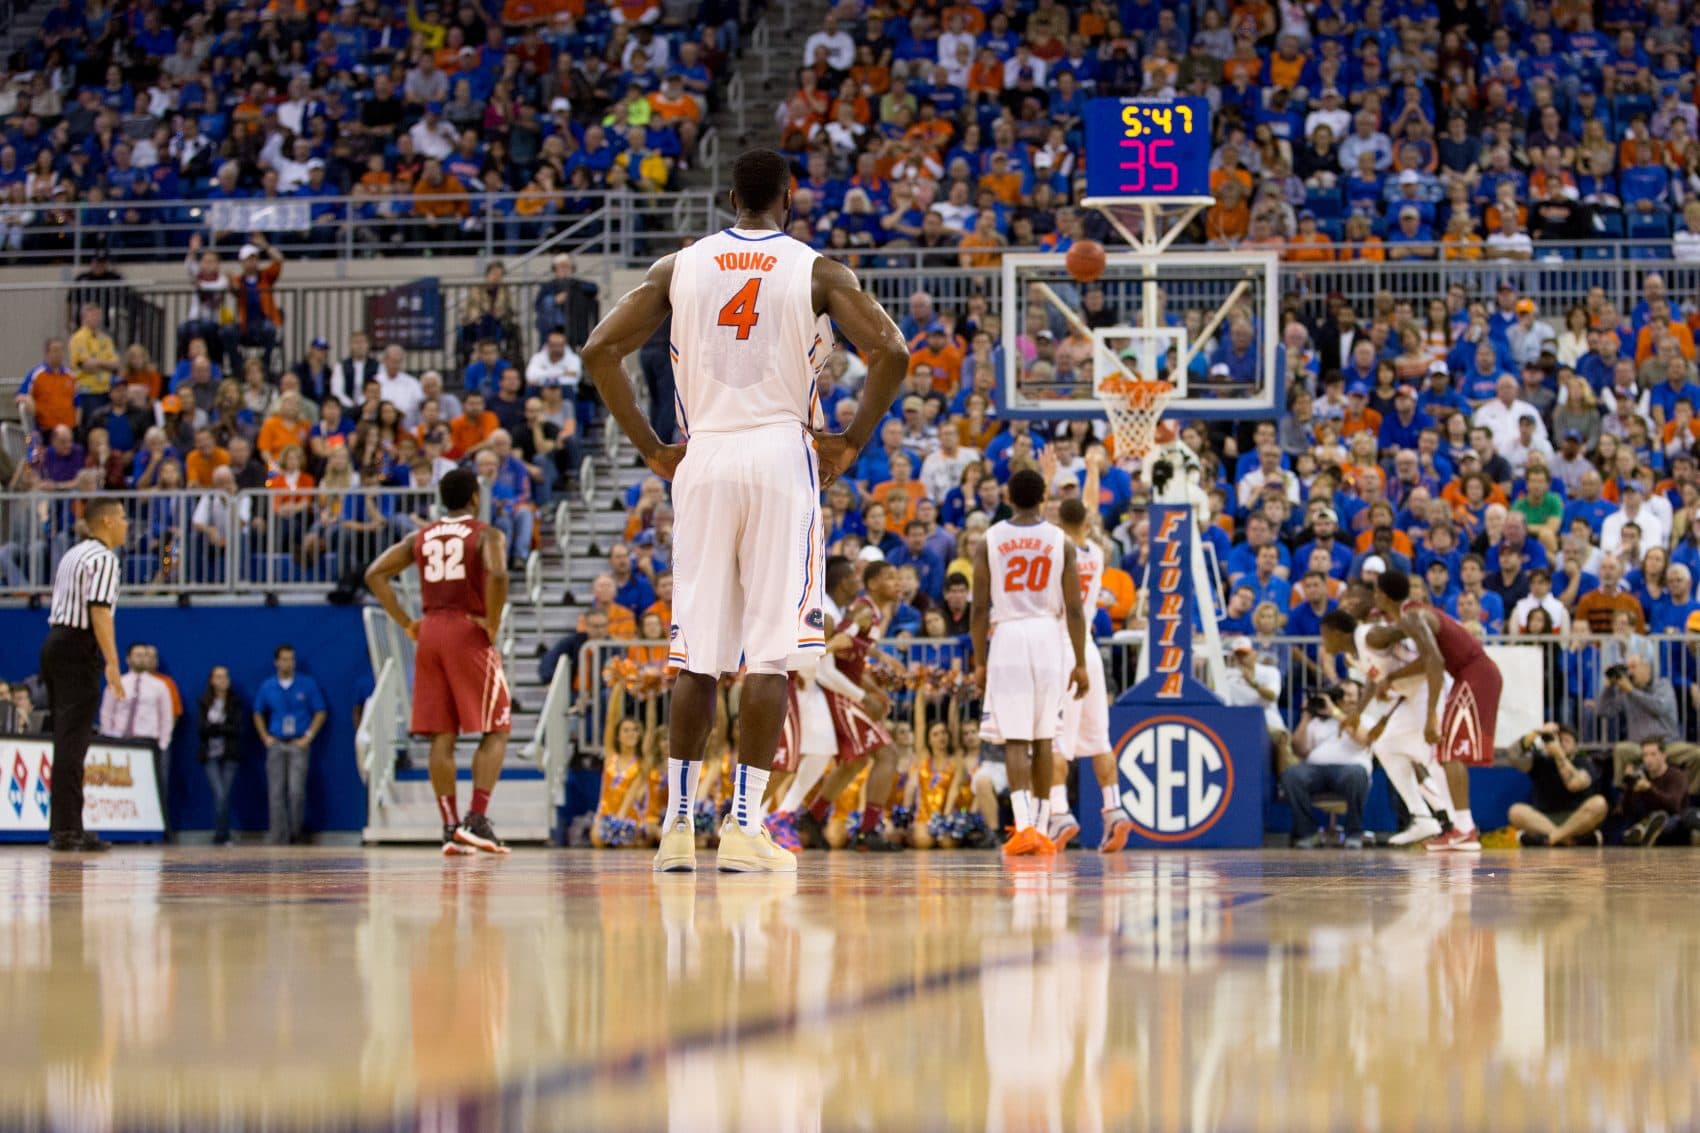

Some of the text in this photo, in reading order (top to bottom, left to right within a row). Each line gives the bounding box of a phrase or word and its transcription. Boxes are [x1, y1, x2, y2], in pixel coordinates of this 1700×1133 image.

[1121, 105, 1193, 138] 5:47
[1119, 139, 1179, 191] 35
[713, 251, 778, 272] YOUNG
[717, 277, 763, 340] 4
[421, 537, 466, 583] 32
[997, 537, 1042, 557] FRAZIER
[1004, 555, 1052, 593] 20
[1154, 510, 1187, 699] FLORIDA
[1118, 723, 1223, 833] SEC
